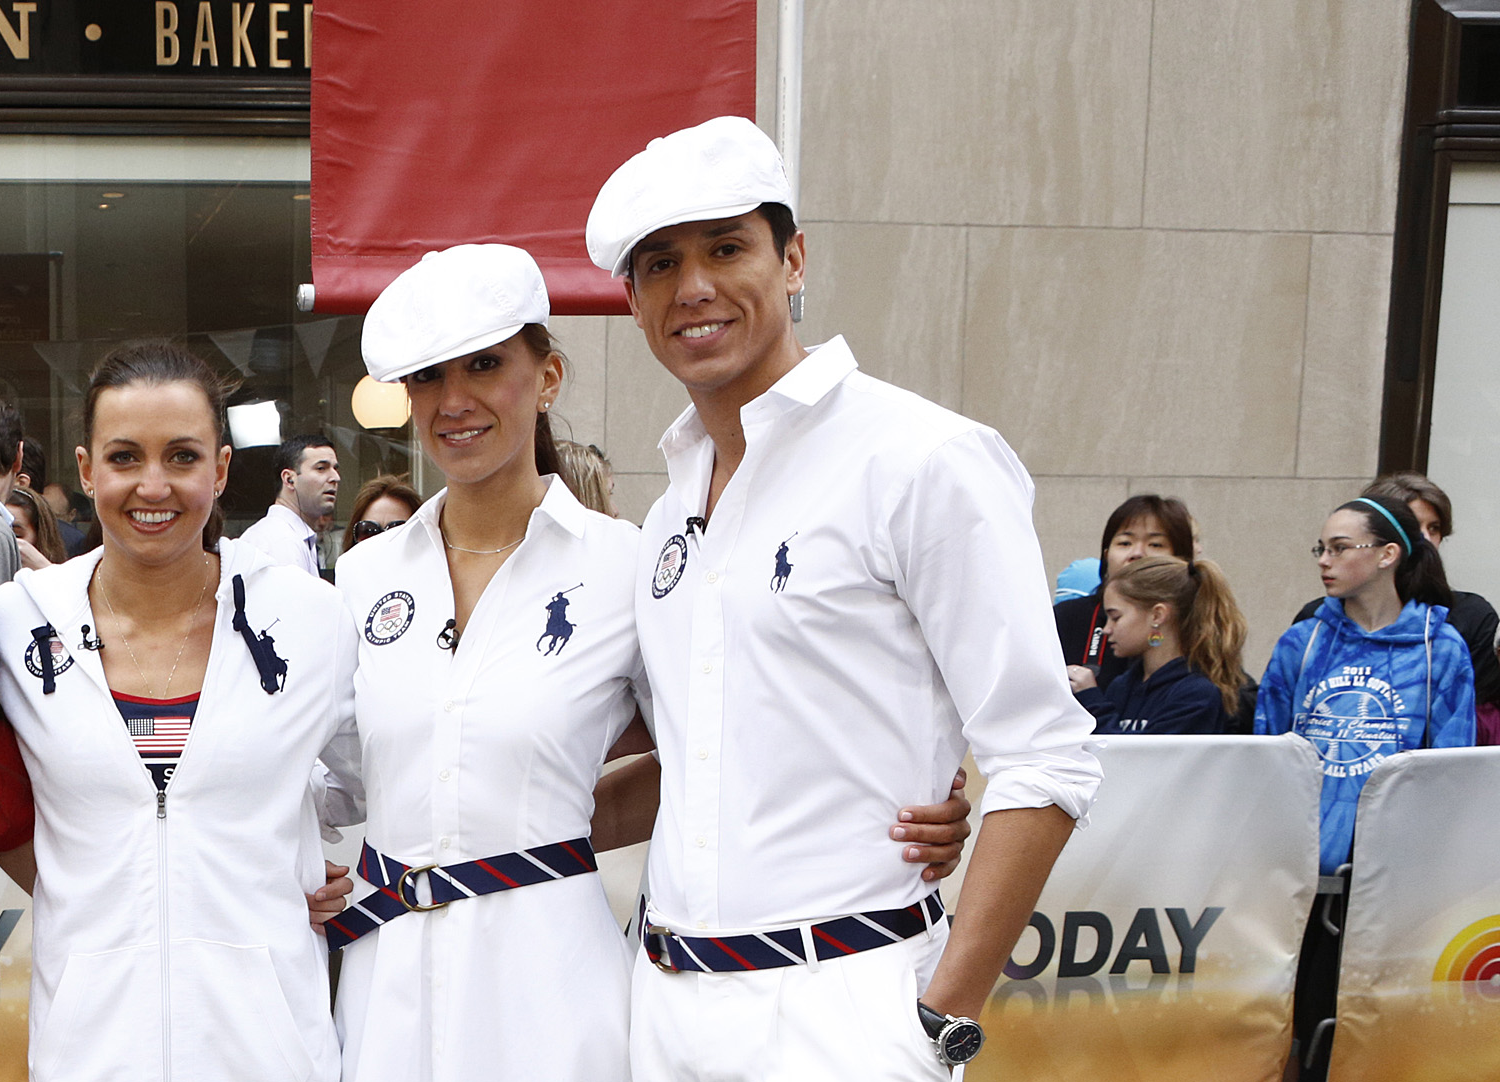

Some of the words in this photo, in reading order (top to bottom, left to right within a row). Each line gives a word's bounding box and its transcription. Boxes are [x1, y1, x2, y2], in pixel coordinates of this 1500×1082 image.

[26, 660, 43, 676] OLYMP
[1342, 666, 1372, 676] 2011
[1323, 764, 1347, 778] ALL
[946, 906, 1225, 980] ODAY
